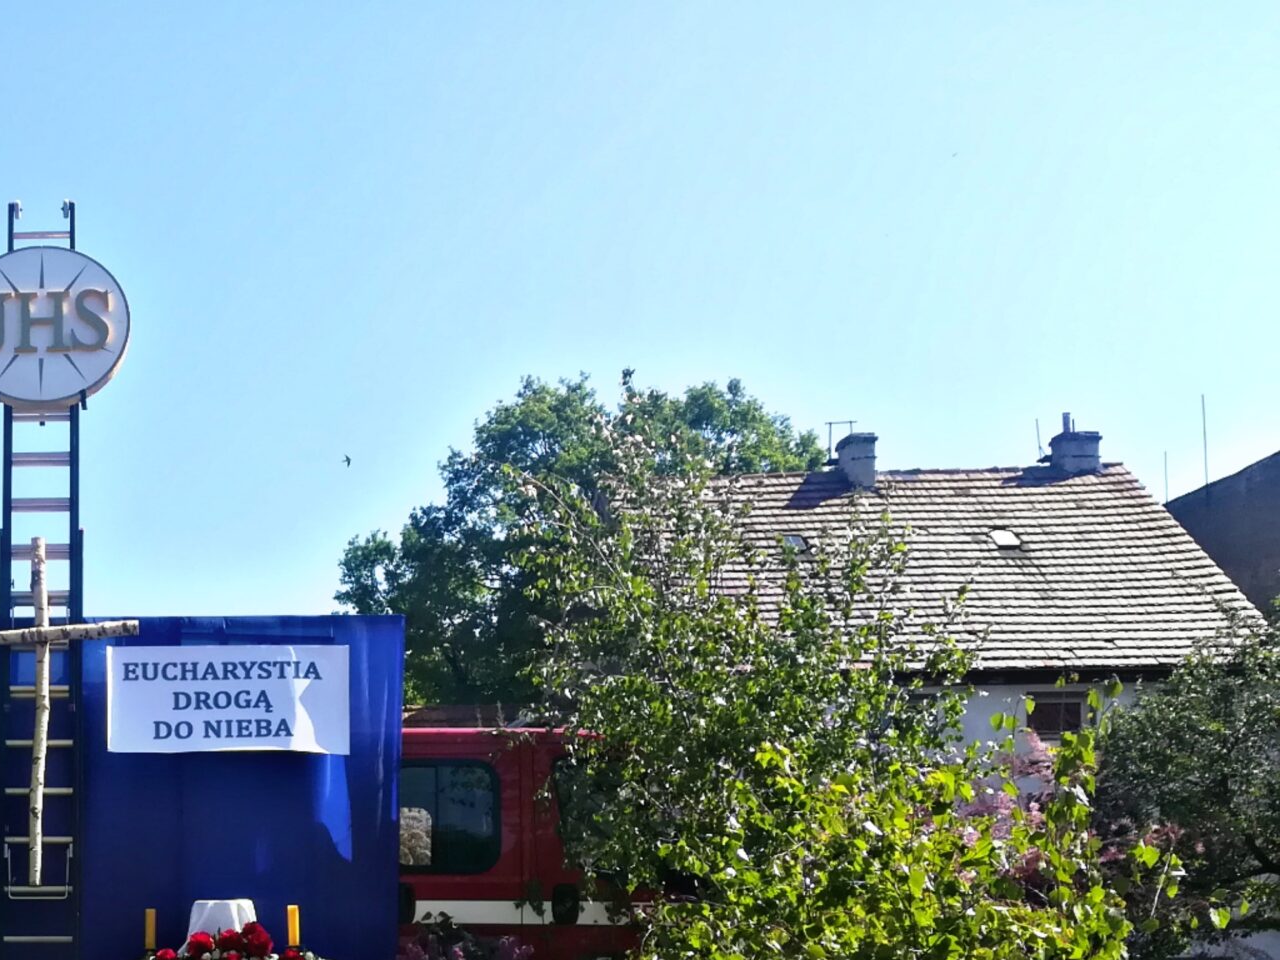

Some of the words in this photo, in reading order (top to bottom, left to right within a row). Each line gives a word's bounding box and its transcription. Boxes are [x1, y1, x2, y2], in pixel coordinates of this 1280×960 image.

[122, 661, 322, 682] EUCHARYSTIA
[172, 690, 273, 713] DROGĄ
[153, 721, 193, 740] DO
[203, 718, 294, 739] NIEBA
